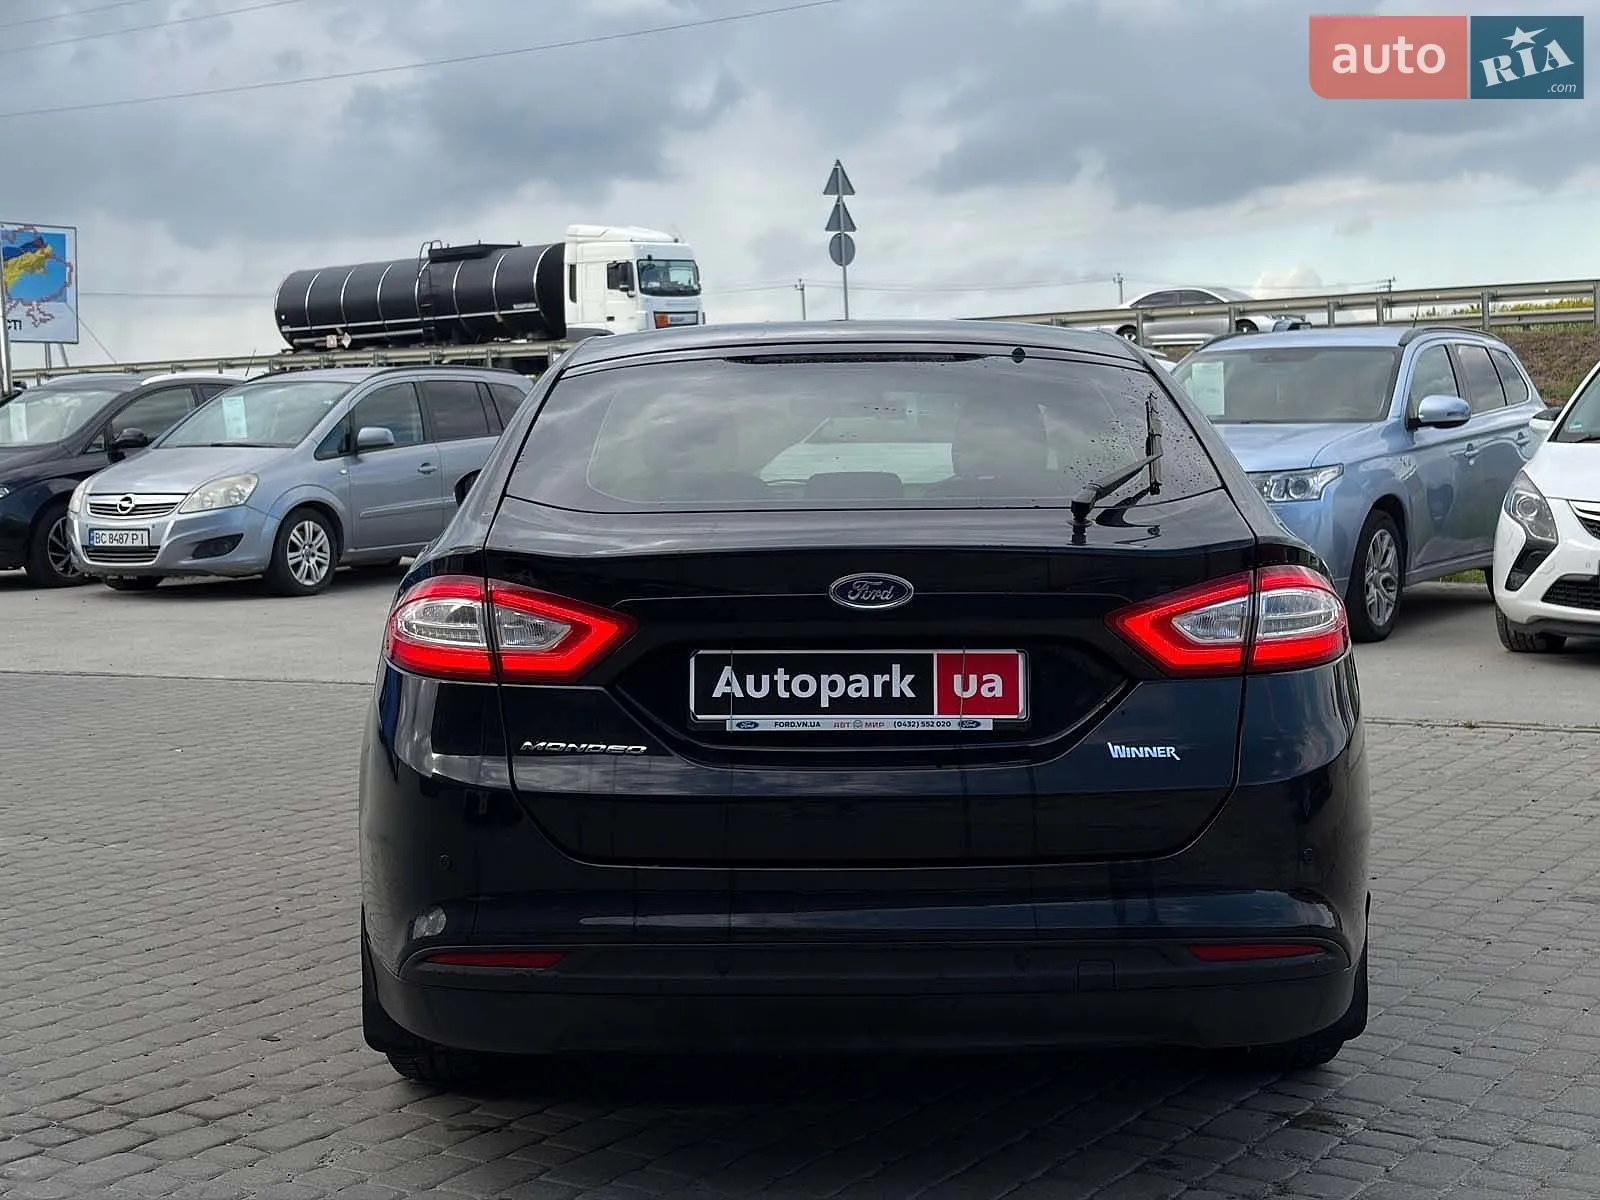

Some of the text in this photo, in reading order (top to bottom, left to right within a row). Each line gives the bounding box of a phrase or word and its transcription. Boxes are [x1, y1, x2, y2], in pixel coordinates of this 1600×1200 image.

[95, 532, 107, 545] BC
[108, 532, 129, 545] 8487
[847, 580, 896, 600] Ford
[711, 664, 917, 708] Autopark
[953, 673, 1003, 699] ua
[893, 720, 920, 729] (0432)
[936, 720, 952, 728] 020
[520, 741, 648, 754] MONDEO
[1107, 741, 1181, 761] WINNER
